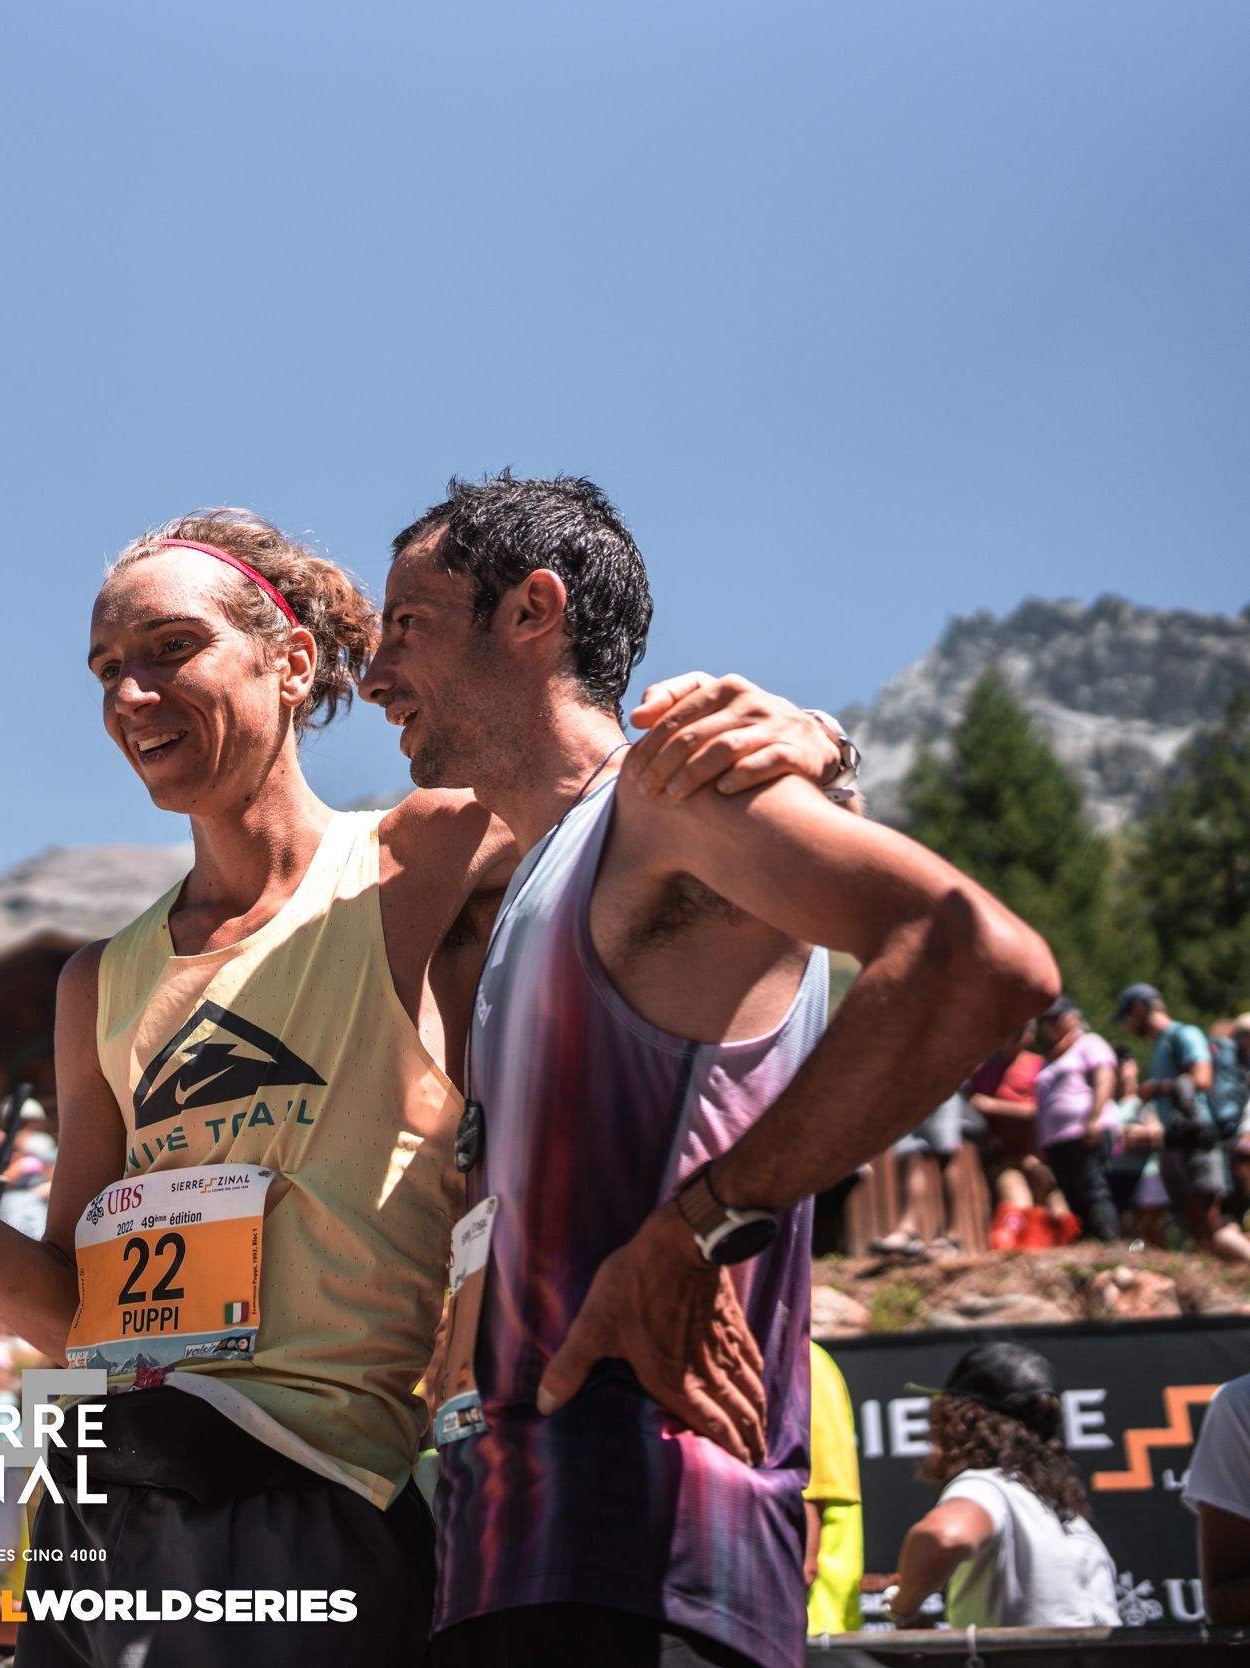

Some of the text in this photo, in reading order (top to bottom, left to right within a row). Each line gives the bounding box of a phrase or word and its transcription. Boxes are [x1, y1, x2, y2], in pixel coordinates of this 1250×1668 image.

[171, 1179, 205, 1193] SIERRE
[217, 1174, 250, 1186] ZINAL
[107, 1184, 143, 1215] UBS
[117, 1219, 134, 1236] 2022
[170, 1211, 202, 1226] édition
[118, 1232, 186, 1306] 22
[122, 1306, 179, 1334] PUPPI
